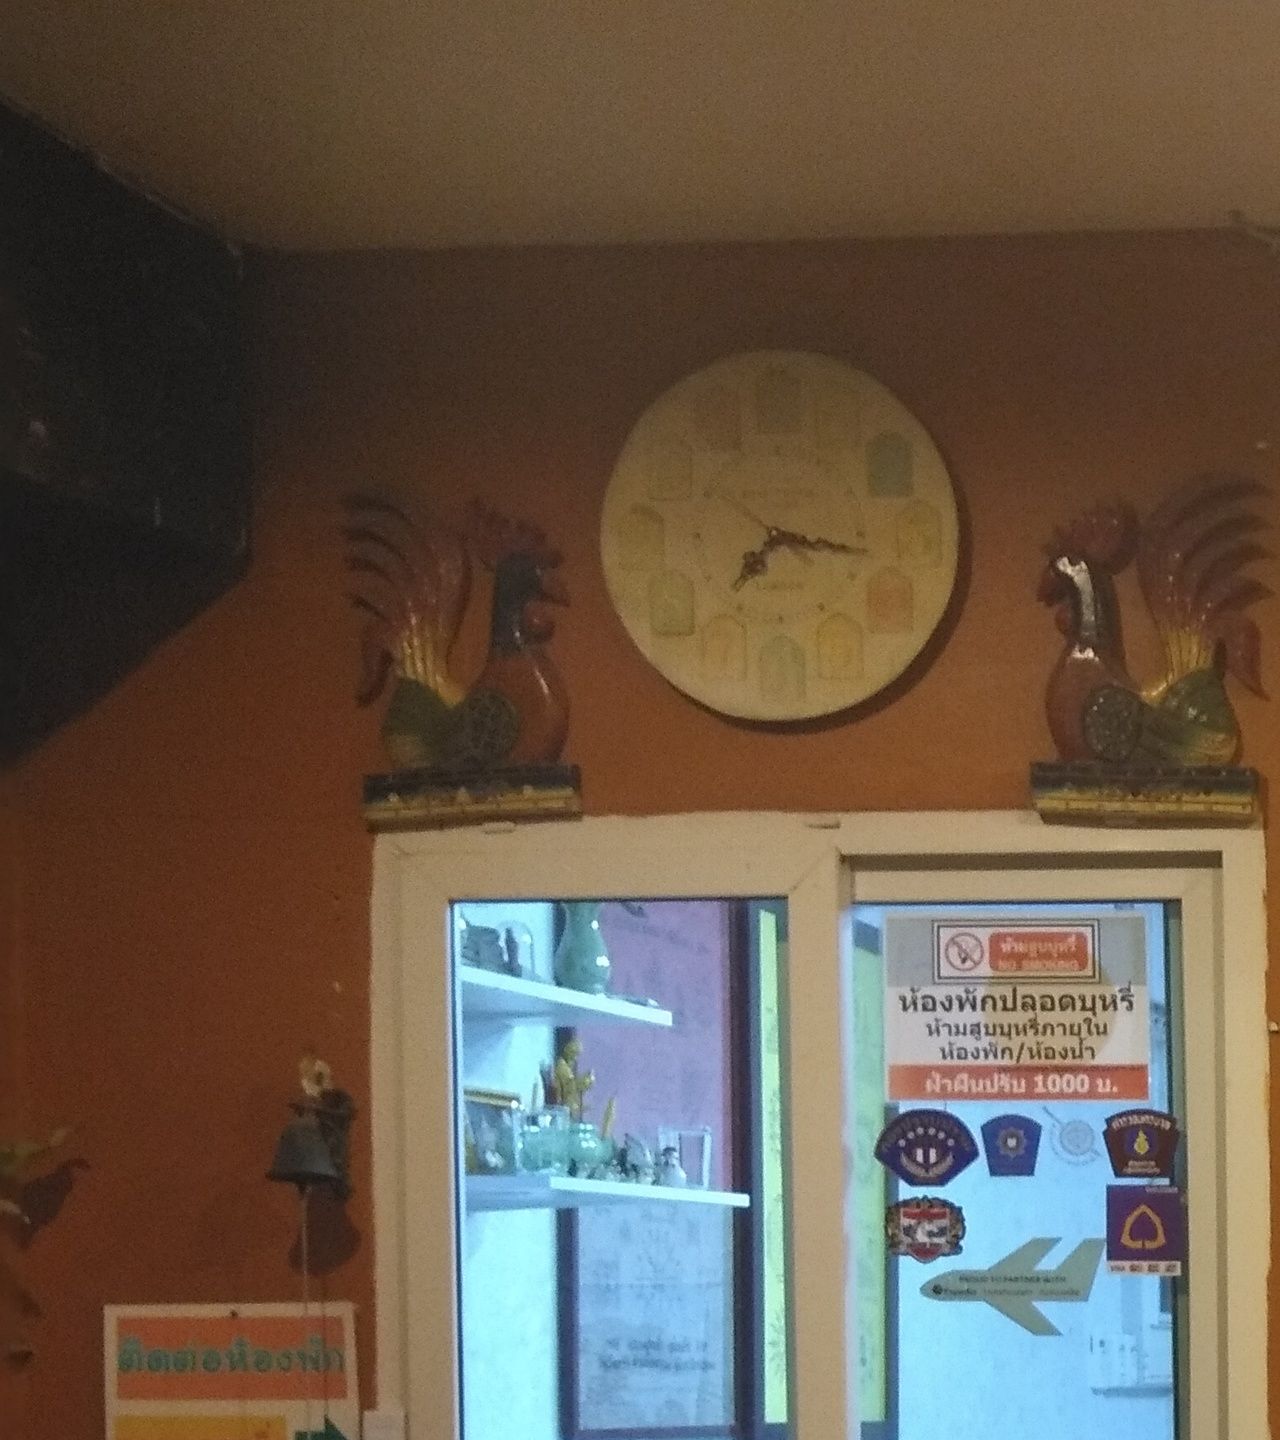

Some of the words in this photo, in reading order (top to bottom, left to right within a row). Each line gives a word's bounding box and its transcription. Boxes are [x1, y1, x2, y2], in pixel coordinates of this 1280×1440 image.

[898, 981, 1136, 1016] ห้องพักปลอดบุหรี่
[925, 1013, 1109, 1041] ห้ามสูบบุหรี่ภายใน
[1034, 1073, 1090, 1095] 1000
